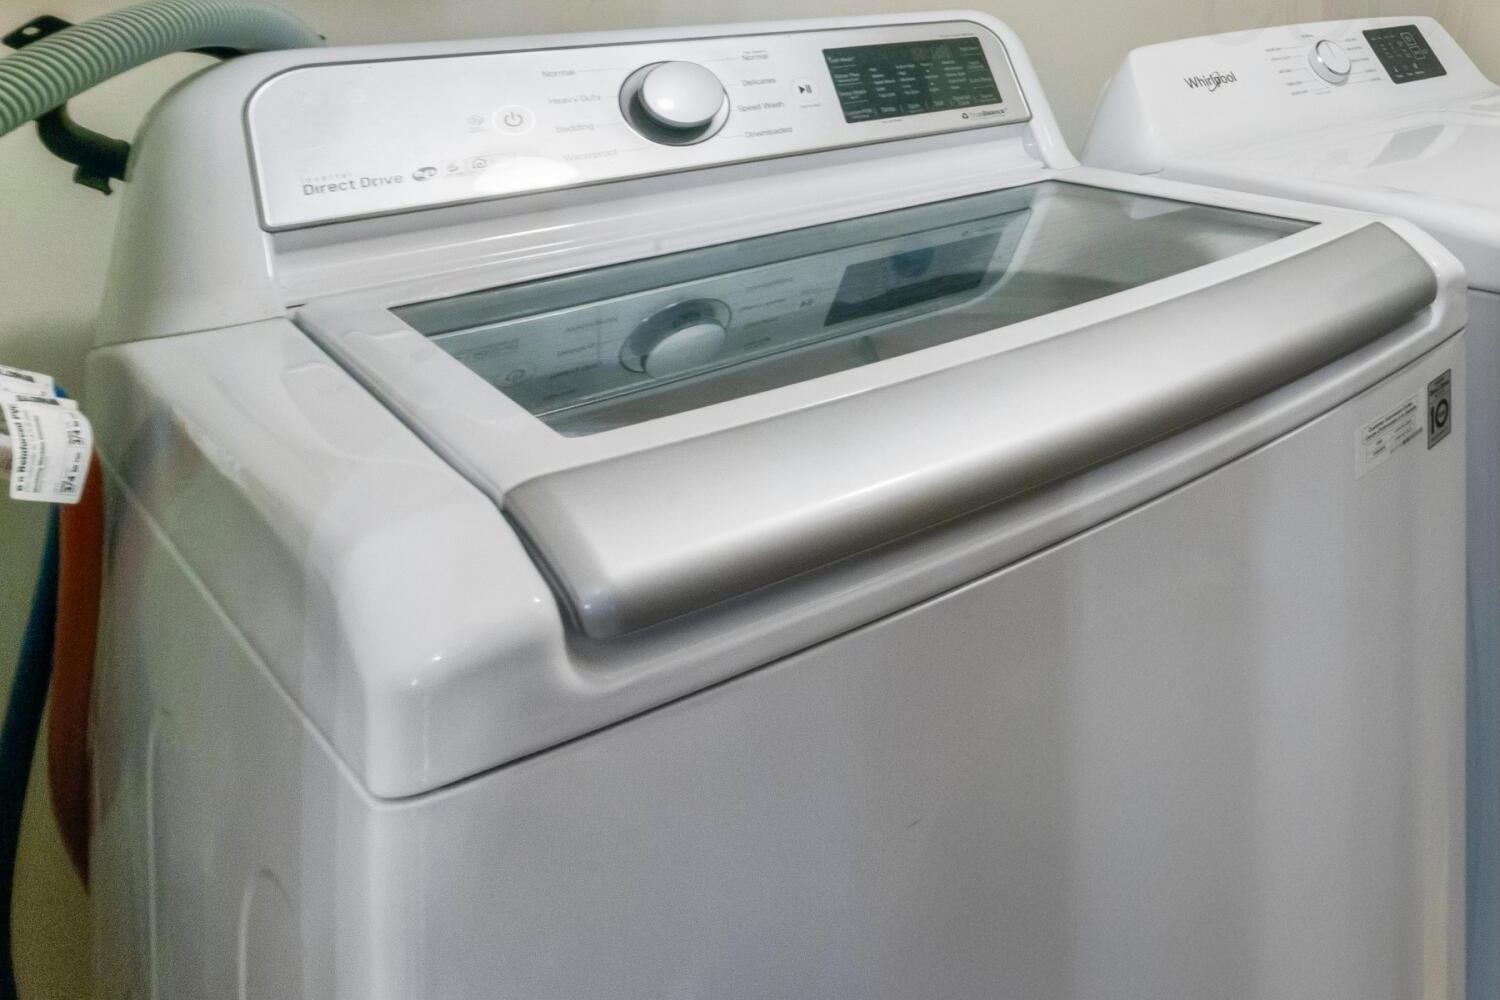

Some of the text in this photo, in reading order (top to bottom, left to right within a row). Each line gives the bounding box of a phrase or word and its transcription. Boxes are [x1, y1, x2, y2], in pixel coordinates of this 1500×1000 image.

[1184, 71, 1238, 92] Whirlpool
[303, 174, 404, 196] Direct Drive
